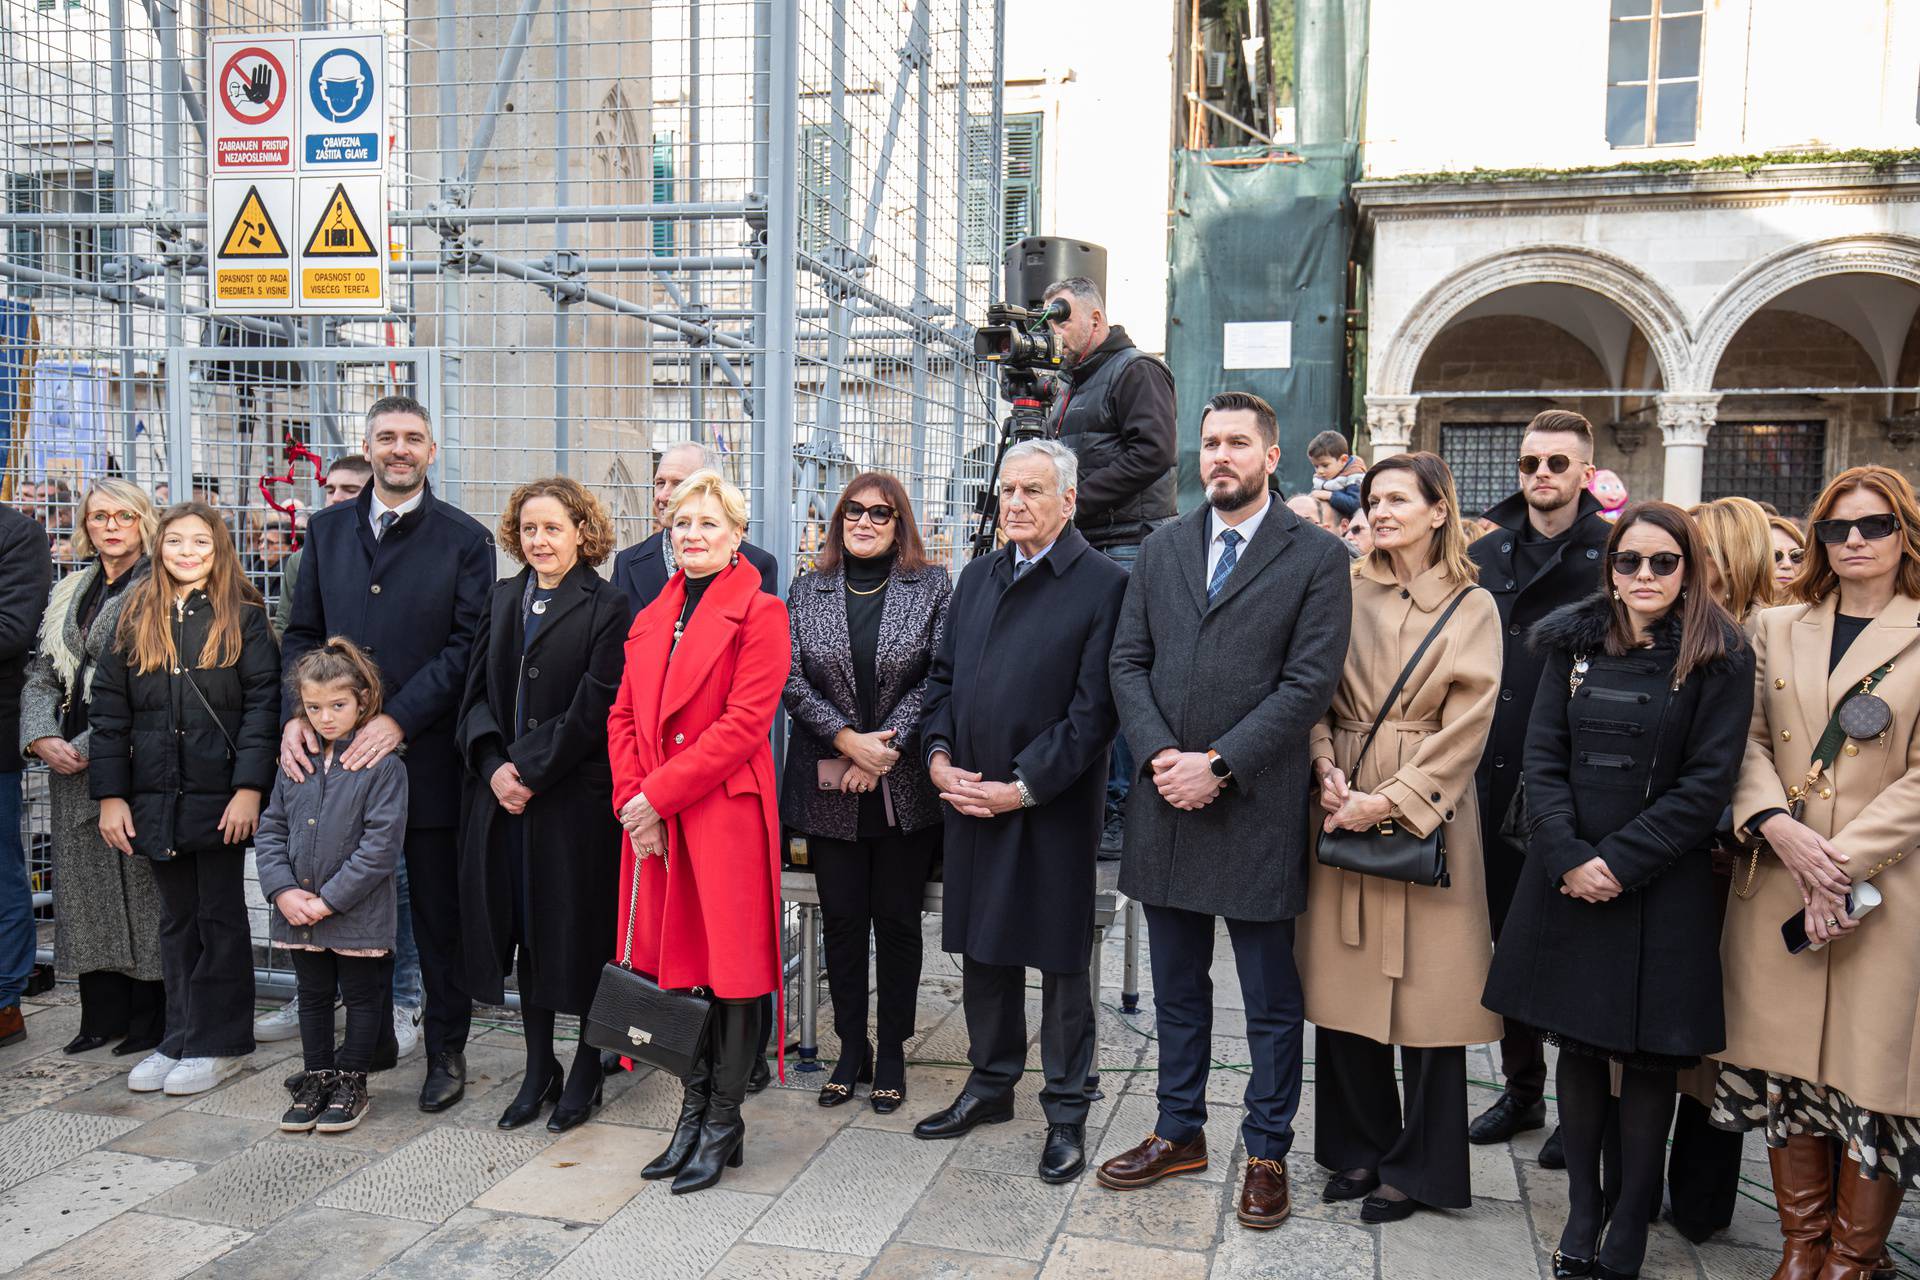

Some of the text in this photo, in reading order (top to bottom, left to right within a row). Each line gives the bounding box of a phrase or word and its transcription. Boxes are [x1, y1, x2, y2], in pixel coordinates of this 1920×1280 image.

[219, 139, 288, 151] ZABRANJEN PRISTUP
[323, 136, 361, 148] OBAVEZNA
[225, 151, 282, 163] NEZAPOSLENIMA
[345, 148, 368, 159] GLAVE
[219, 274, 287, 283] OPASNOST OD PADA
[314, 272, 366, 282] OPASNOST OD
[220, 286, 287, 295] PREDMETA S VISINE
[344, 284, 370, 294] TERETA
